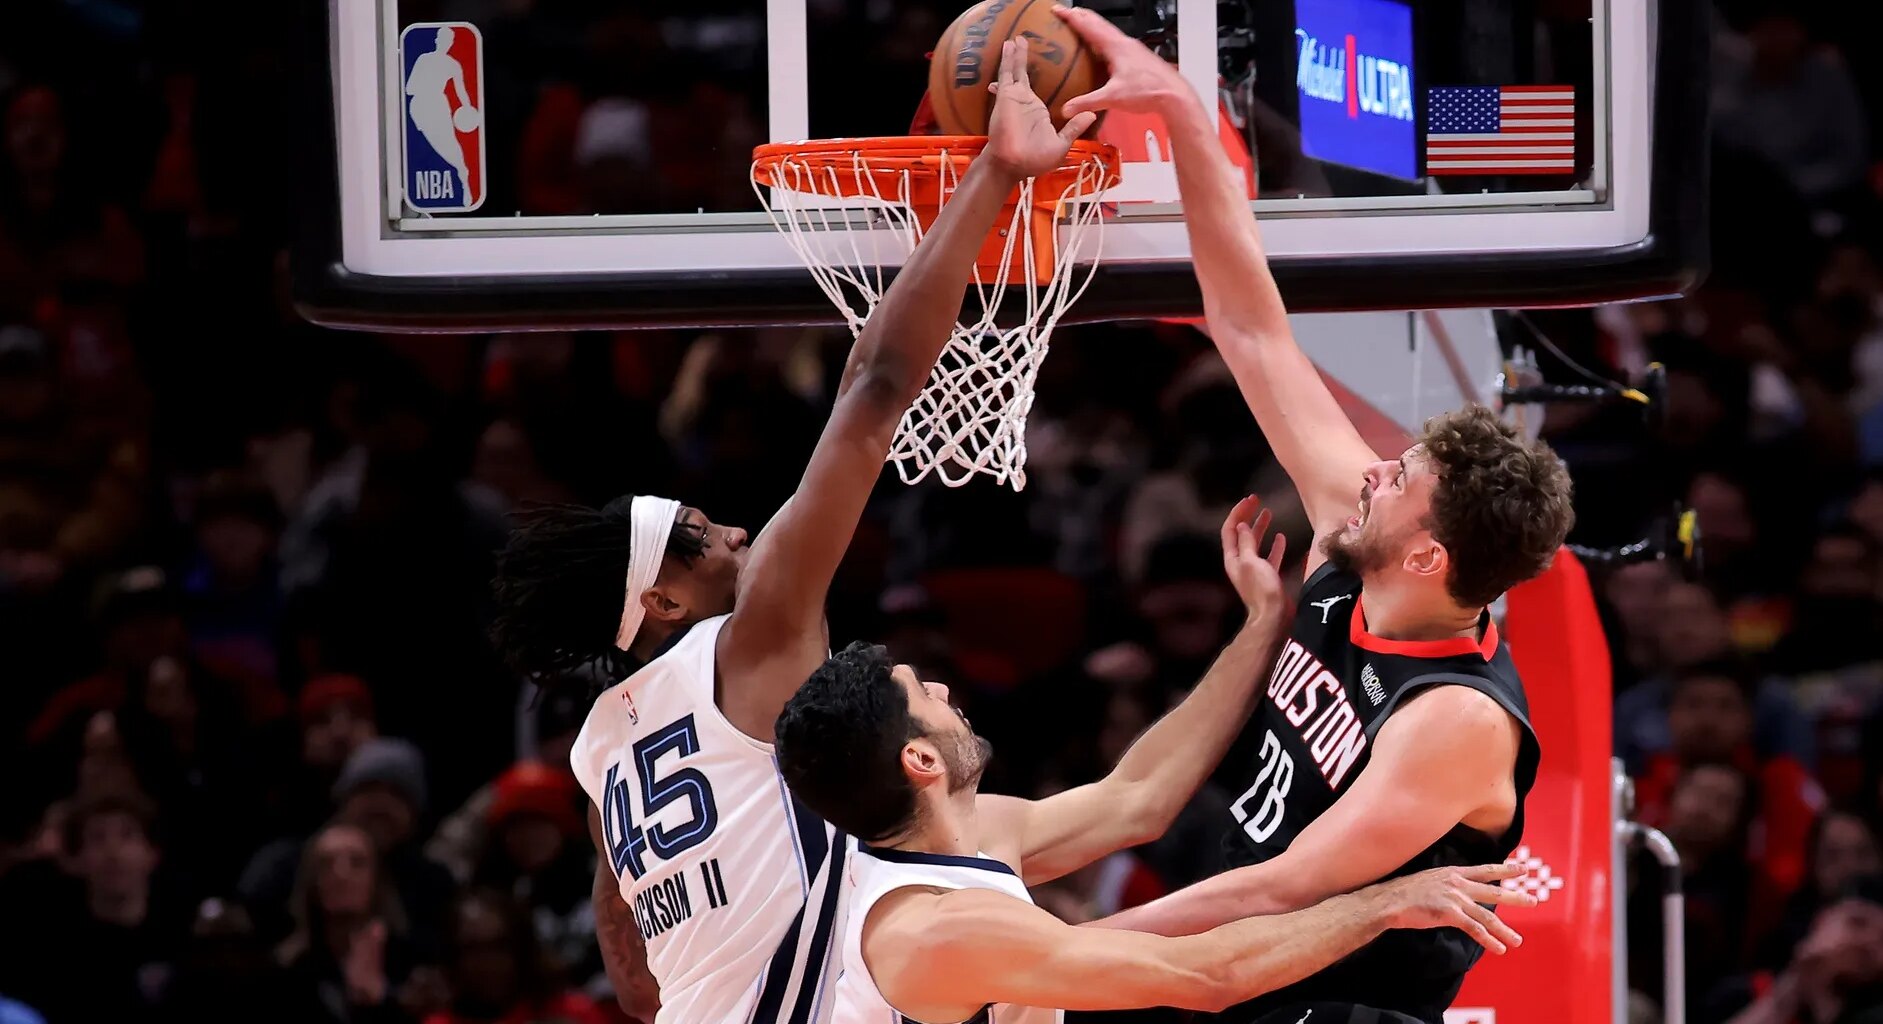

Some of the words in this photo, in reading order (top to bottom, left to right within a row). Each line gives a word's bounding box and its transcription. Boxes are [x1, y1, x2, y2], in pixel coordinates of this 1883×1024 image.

[955, 0, 1015, 89] Wilso
[1357, 54, 1414, 121] ULTRA
[415, 170, 454, 200] NBA
[1267, 637, 1367, 790] OUSTON
[603, 713, 718, 881] 45
[1229, 729, 1294, 843] 28
[634, 870, 692, 940] CKSON
[700, 858, 728, 909] II
